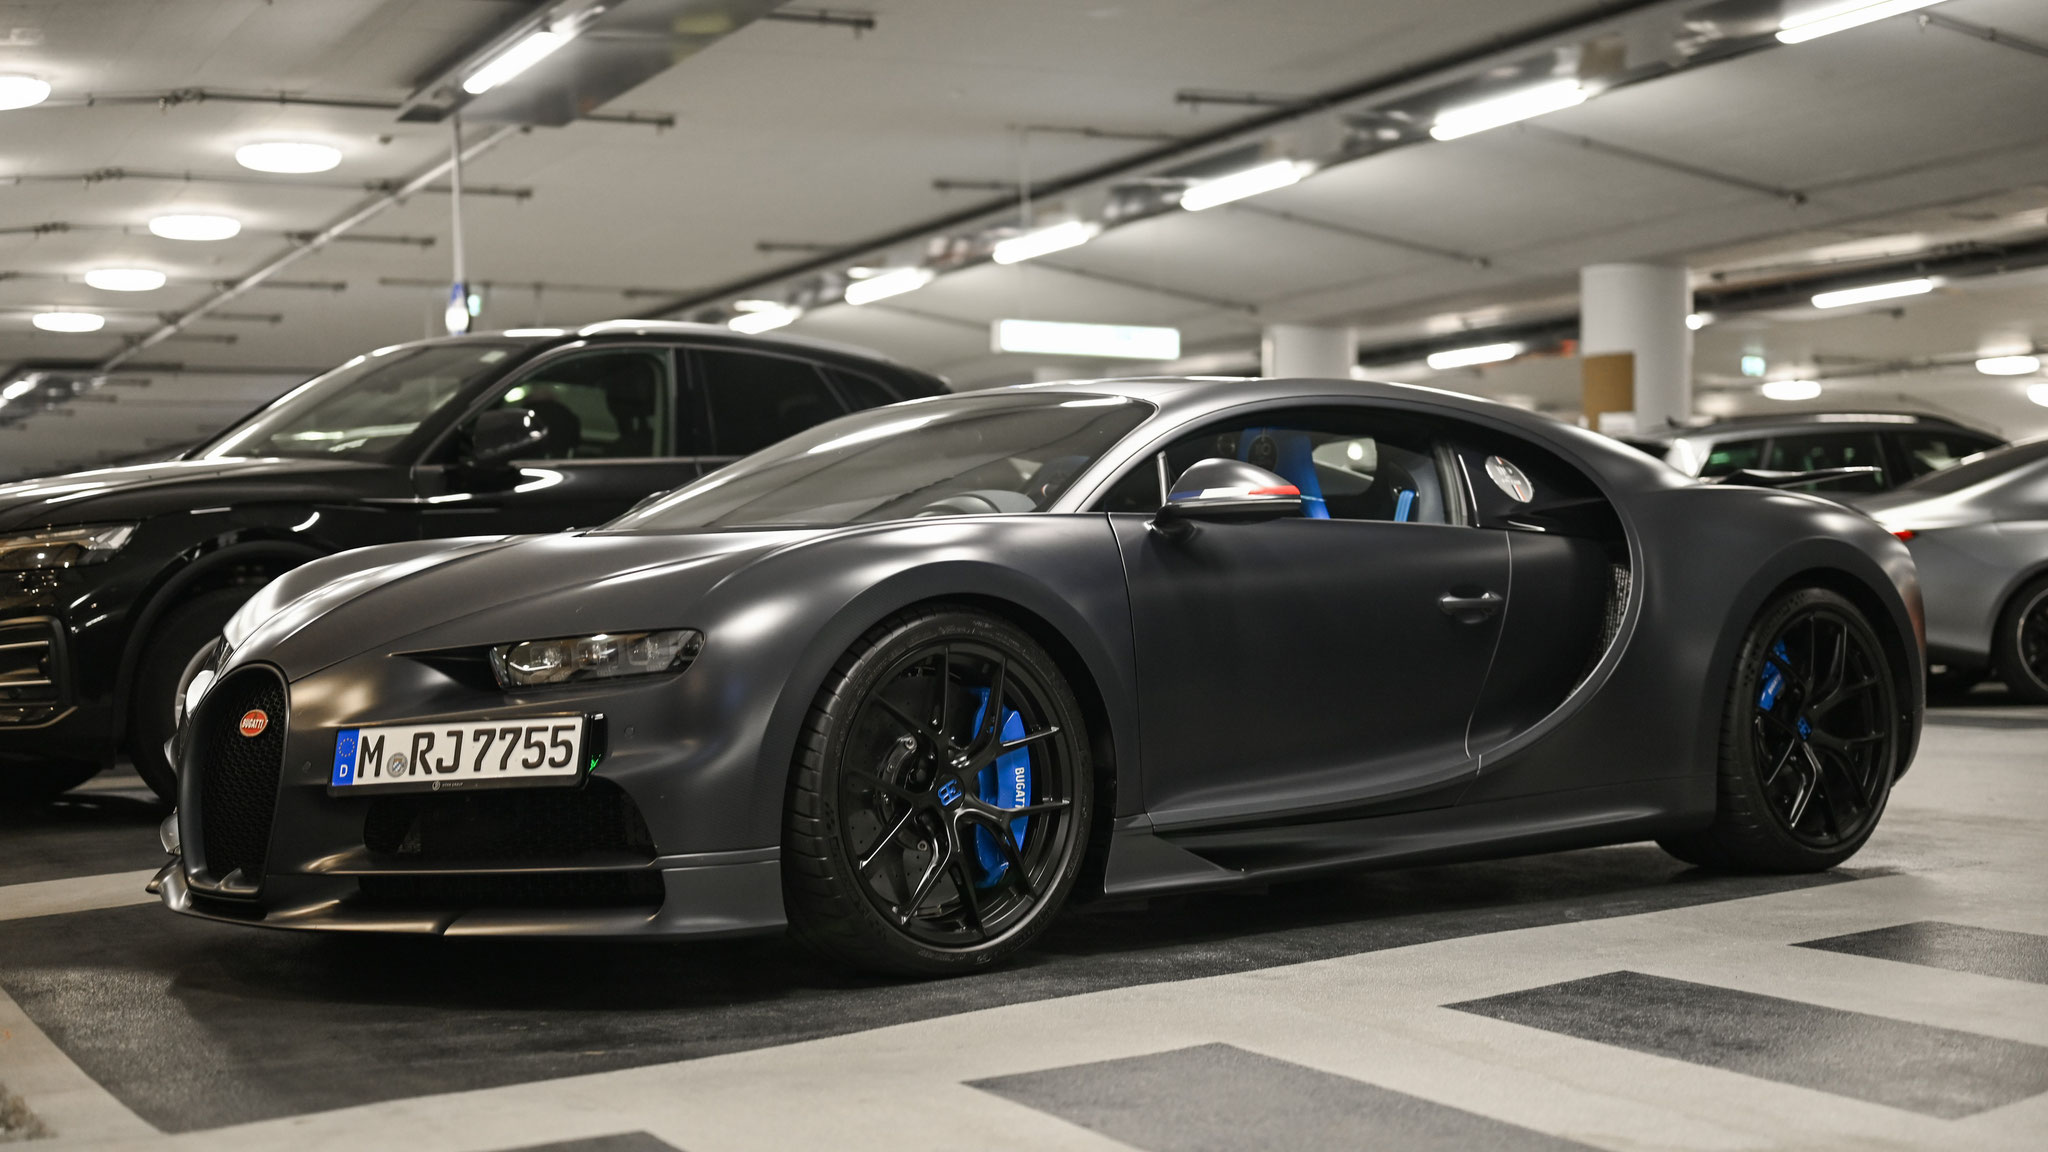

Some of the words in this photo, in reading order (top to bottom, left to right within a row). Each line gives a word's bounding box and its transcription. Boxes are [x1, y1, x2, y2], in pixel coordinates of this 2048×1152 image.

[241, 718, 265, 729] BUGATTI
[357, 735, 385, 778] M
[339, 764, 348, 777] D
[1015, 767, 1026, 809] BUGATT
